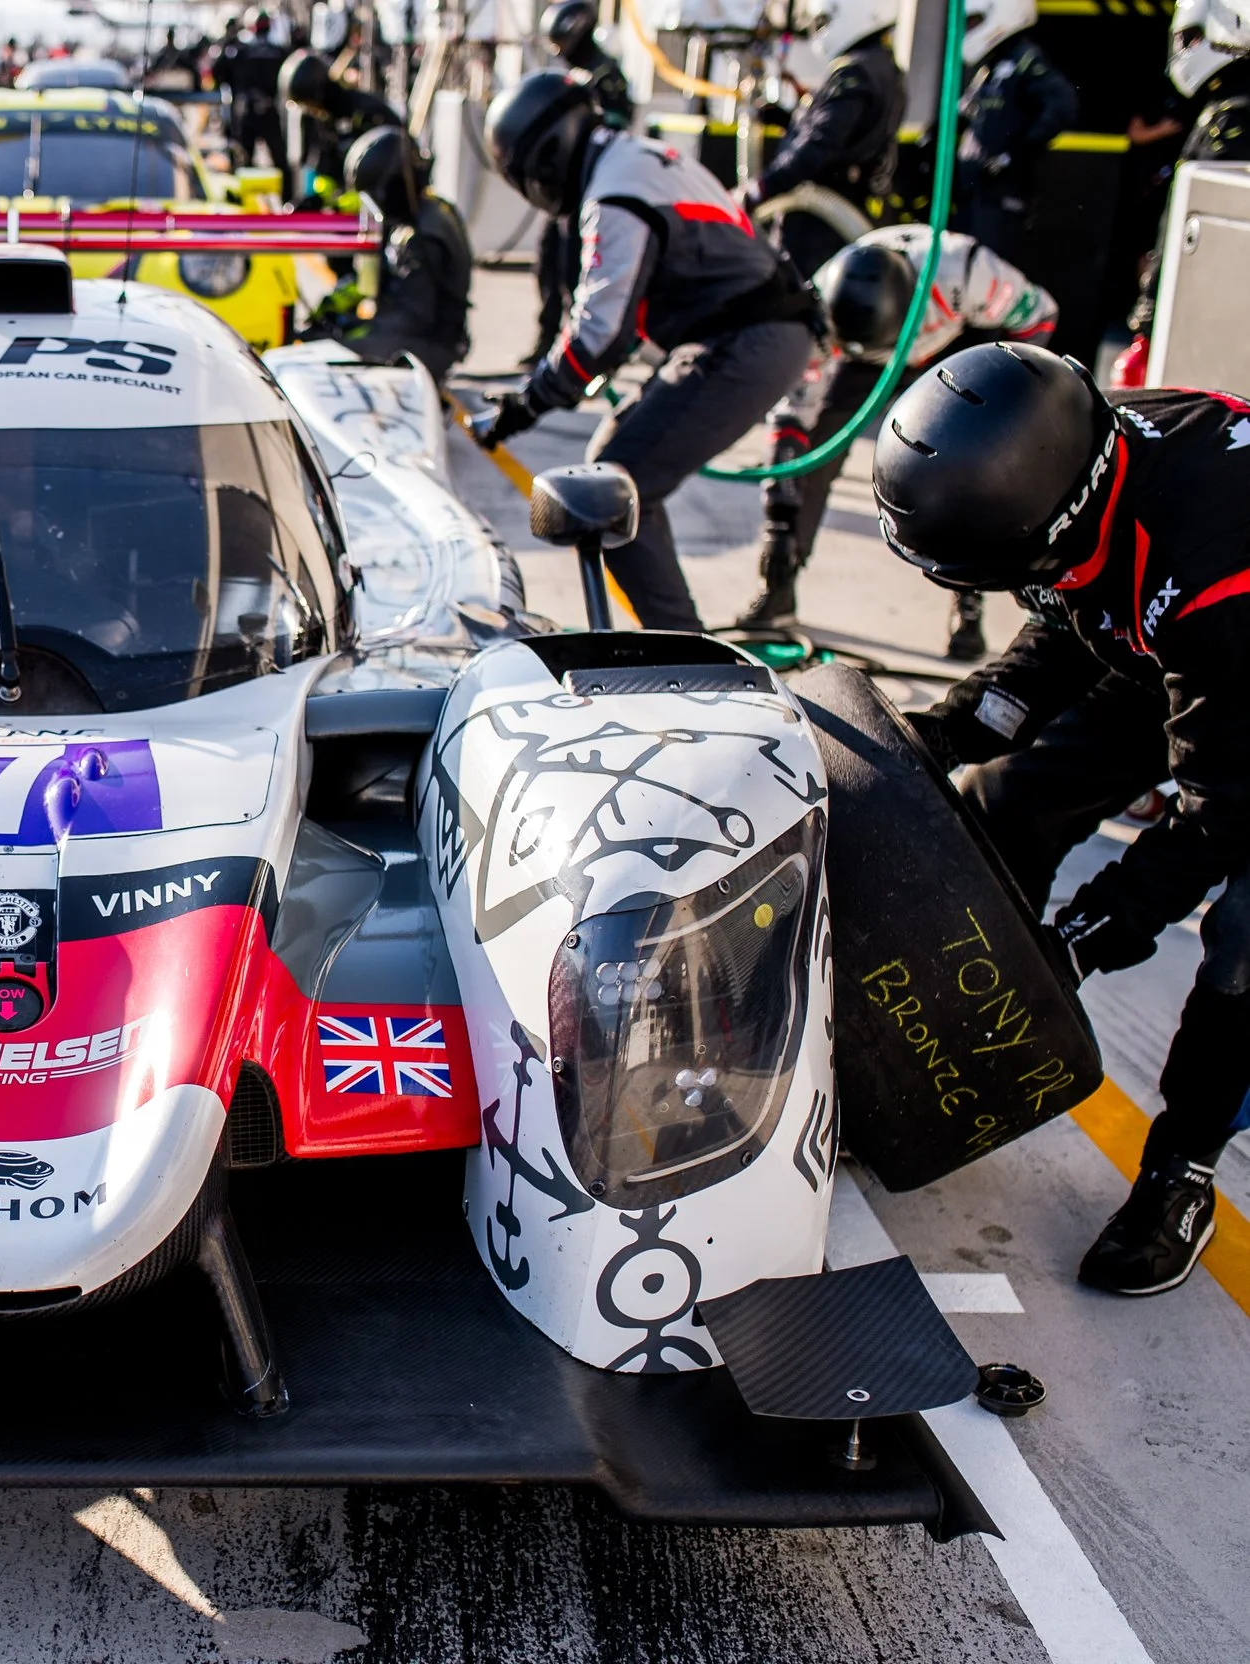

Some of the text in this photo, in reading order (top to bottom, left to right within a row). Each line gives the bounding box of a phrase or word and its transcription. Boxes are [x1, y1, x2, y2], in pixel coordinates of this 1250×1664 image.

[54, 372, 88, 381] CAR
[92, 374, 183, 396] SPECIALIST
[1143, 576, 1181, 637] HRX
[91, 870, 221, 917] VINNY
[942, 906, 1038, 1054] TONY
[861, 959, 979, 1116] BRONZE
